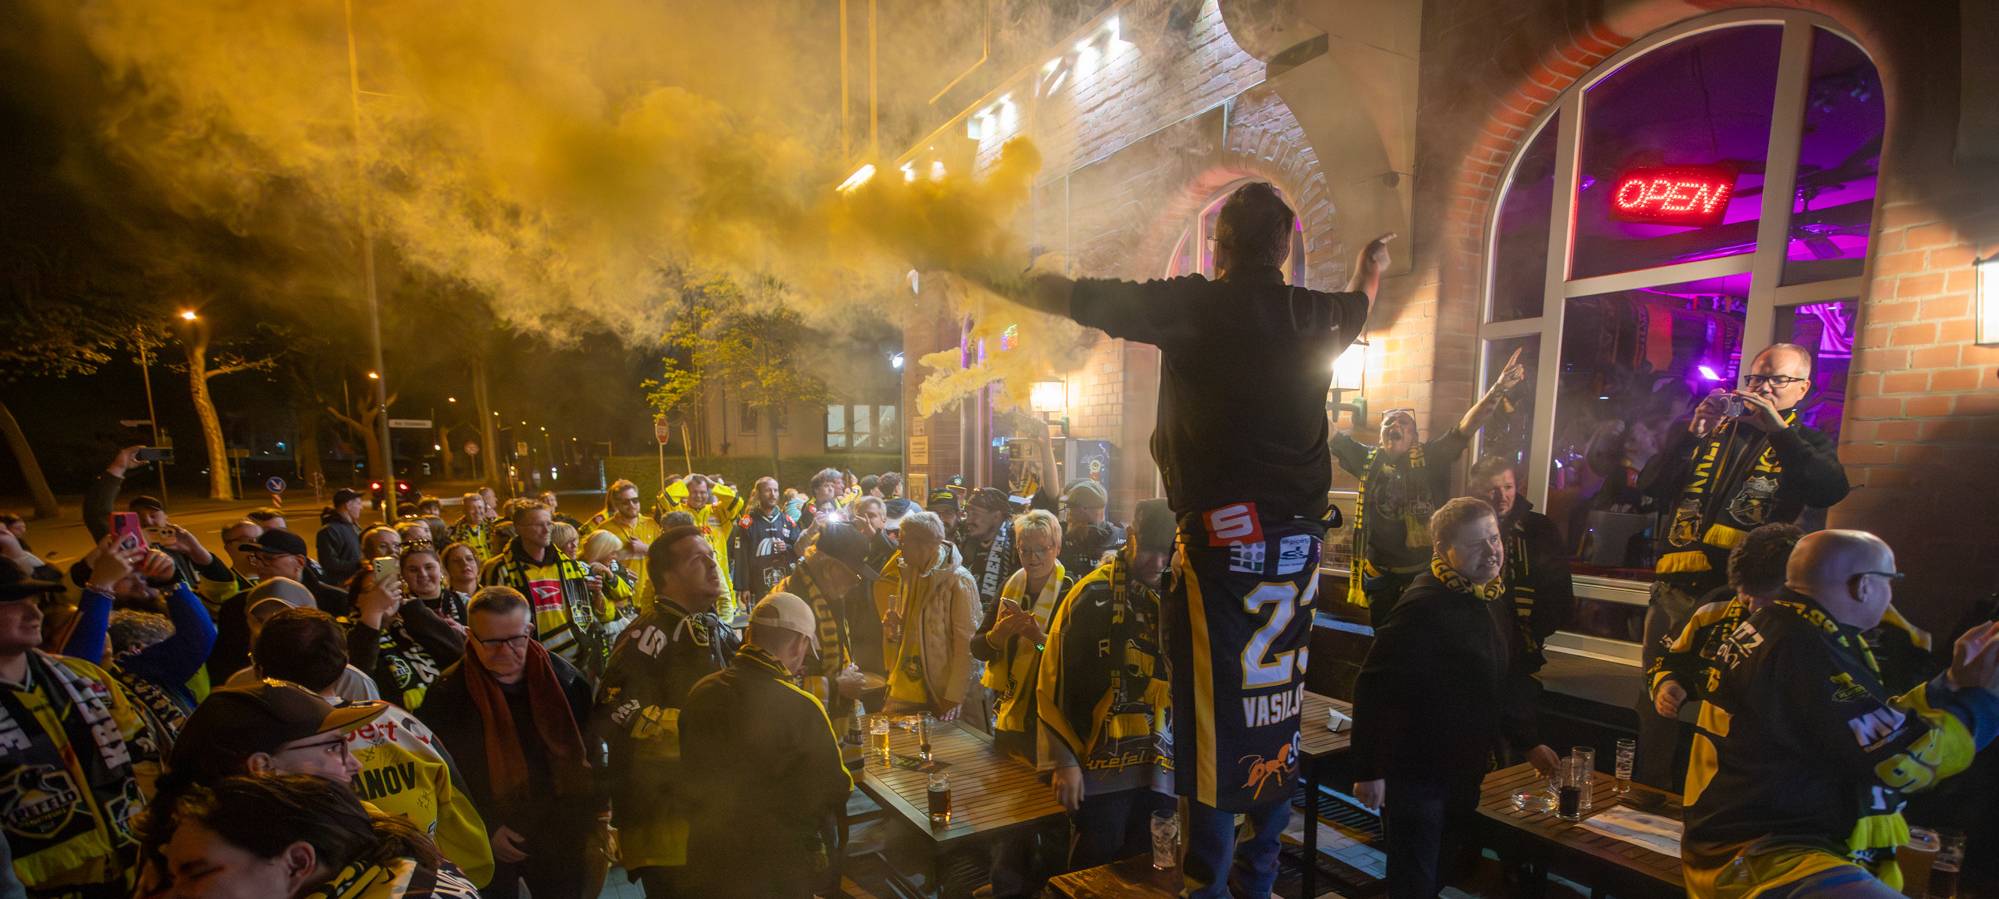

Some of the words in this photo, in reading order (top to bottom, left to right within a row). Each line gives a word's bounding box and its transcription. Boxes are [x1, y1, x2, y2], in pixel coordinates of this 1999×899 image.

[1617, 178, 1729, 213] OPEN
[1241, 681, 1306, 730] VASILJ
[351, 760, 417, 801] ANOV
